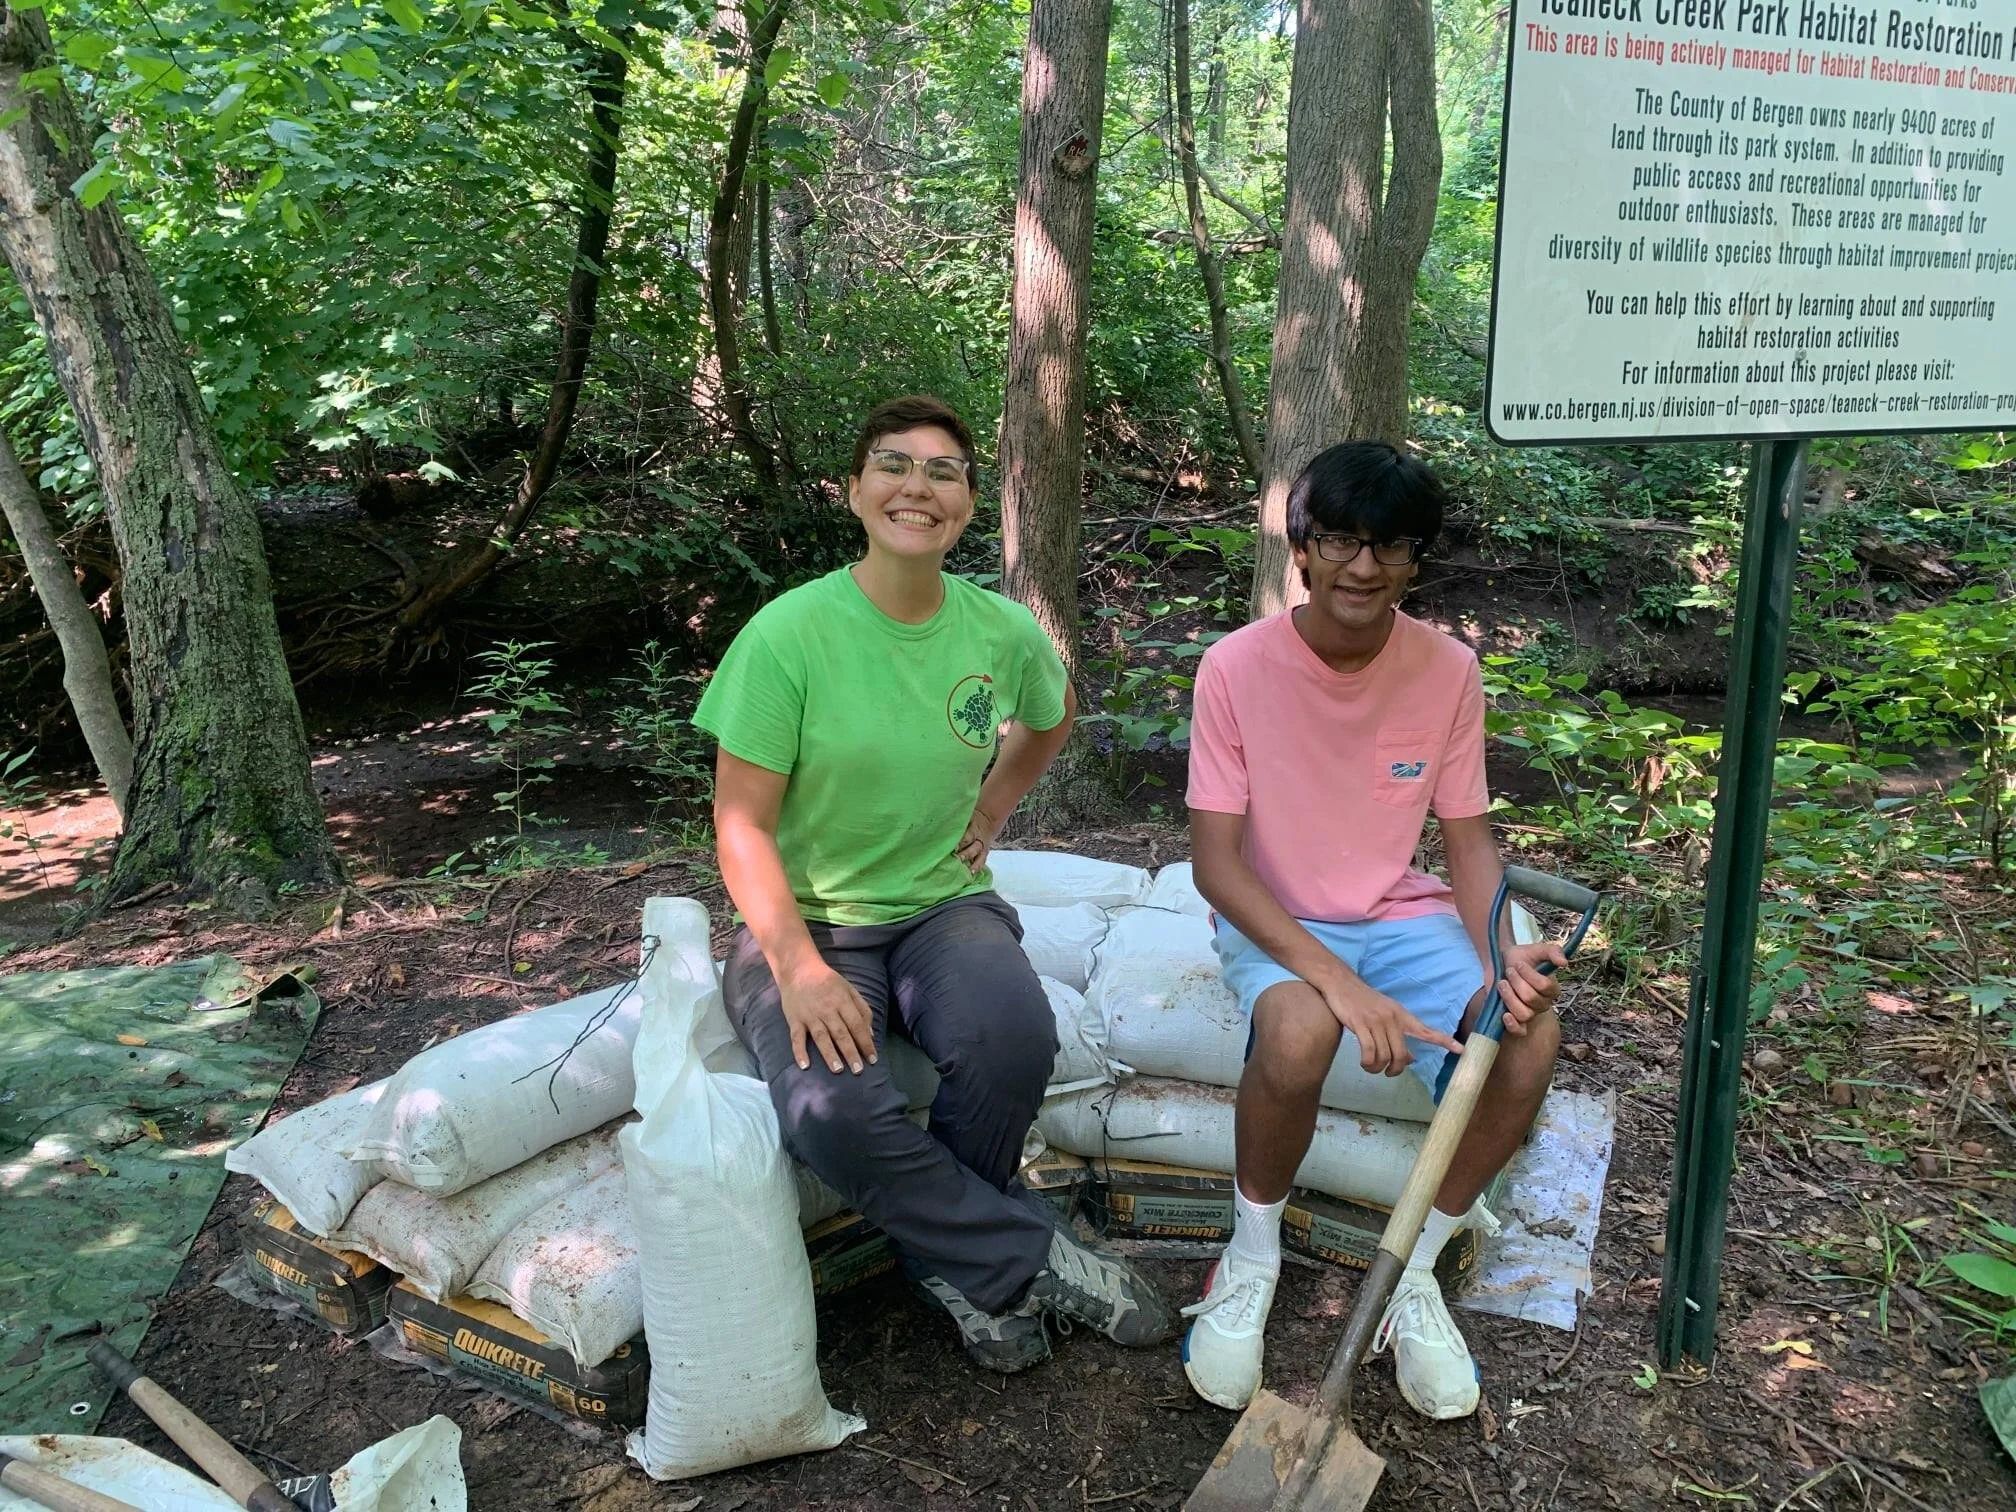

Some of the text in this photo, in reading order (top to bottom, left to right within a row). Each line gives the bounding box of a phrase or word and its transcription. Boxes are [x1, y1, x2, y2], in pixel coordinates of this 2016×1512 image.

[1656, 0, 1725, 30] Creek
[1737, 0, 1789, 37] Park
[1798, 0, 1878, 45] Habitat
[1886, 9, 2003, 60] Restoration
[1526, 24, 2016, 94] This area is being actively managed for Habitat Restoration and Conserv
[1636, 87, 1995, 140] The County of Bergen owns nearly 9400 acres of
[1611, 122, 2004, 176] land through its park system. In addition to providing
[1633, 162, 1982, 202] public access and recreational opportunities for
[1619, 197, 1987, 236] outdoor enthusiasts. These areas are managed for
[1549, 234, 1622, 264] diversity
[1629, 236, 1646, 261] of
[1652, 237, 1708, 263] wildlife
[1715, 241, 1772, 267] species
[1779, 242, 1832, 269] through
[1837, 243, 1884, 267] habitat
[1890, 244, 1972, 271] improvement
[1587, 289, 1995, 321] You can help this effort by learning about and supporting
[1697, 325, 1900, 349] habitat restoration activities
[1622, 359, 1956, 386] For information about this project please visit:
[1143, 1207, 1165, 1217] MIX
[1143, 1223, 1222, 1238] QUIKRETE
[255, 1249, 309, 1287] QUIKRETE
[1319, 1245, 1371, 1270] KRETE
[317, 1292, 331, 1303] 60
[453, 1327, 546, 1380] QUIKRETE
[578, 1396, 607, 1412] 60
